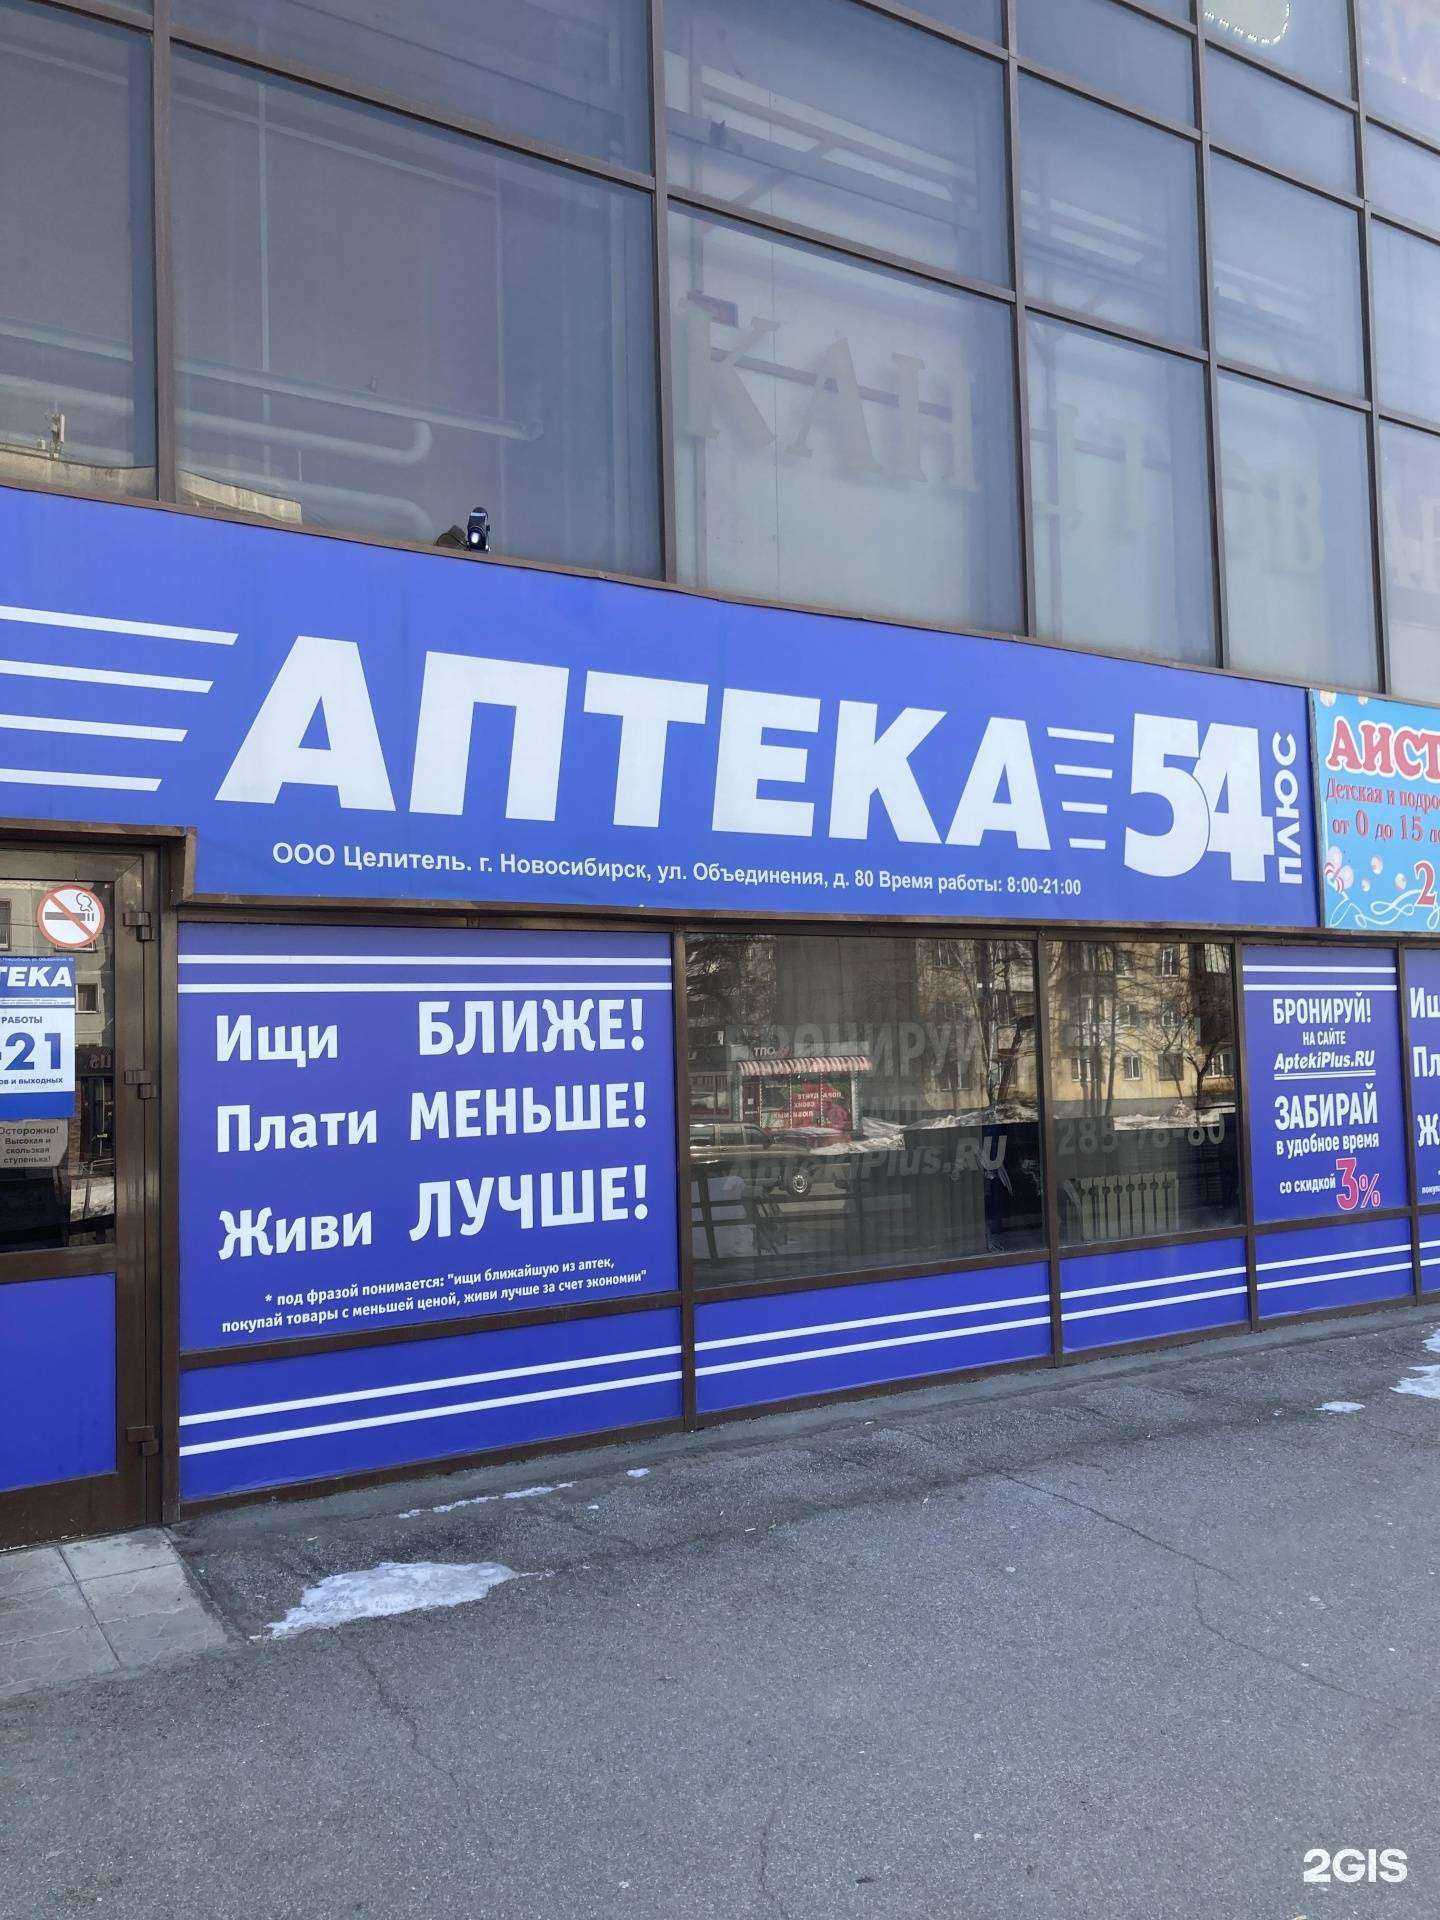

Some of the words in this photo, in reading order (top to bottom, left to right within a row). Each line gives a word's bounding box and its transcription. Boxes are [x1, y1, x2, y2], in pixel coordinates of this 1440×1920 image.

[214, 635, 1051, 850] АПТЕКА
[1123, 713, 1275, 883] 54
[1272, 732, 1303, 884] ПЛЮС
[1326, 777, 1383, 804] Детская
[1387, 790, 1395, 806] и
[1400, 791, 1440, 815] подро
[1332, 819, 1350, 835] от
[1356, 809, 1369, 836] 0
[1374, 824, 1394, 841] до
[1400, 815, 1424, 842] 15
[272, 842, 336, 866] ООО
[344, 845, 472, 872] Целитель.
[479, 856, 493, 873] г.
[500, 853, 652, 882] Новосибирск,
[657, 863, 688, 882] ул.
[693, 862, 829, 888] Объединения,
[833, 872, 850, 888] д.
[854, 869, 875, 888] 80
[879, 870, 934, 893] Время
[938, 876, 1003, 894] работы:
[1006, 876, 1083, 896] 8:00-21:00
[1, 1016, 43, 1024] РАБОТЫ
[1272, 992, 1372, 1024] БРОНИРУЙ!
[0, 1031, 61, 1070] 21
[215, 1013, 339, 1068] Ищи
[417, 998, 646, 1057] БЛИЖЕ!
[1303, 1031, 1316, 1046] НА
[1317, 1027, 1346, 1046] САЙТЕ
[19, 1077, 64, 1086] выходных
[1274, 1050, 1375, 1073] AptekiPlus.RU
[216, 1103, 378, 1153] Плати
[410, 1081, 647, 1142] МЕНЬШЕ!
[1274, 1083, 1378, 1131] ЗАБИРАЙ
[1276, 1140, 1284, 1156] в
[1287, 1133, 1340, 1159] удобное
[1342, 1133, 1380, 1153] время
[1280, 1181, 1292, 1194] со
[1294, 1173, 1336, 1193] скидкой
[1335, 1157, 1381, 1211] 3%
[218, 1205, 374, 1261] Живи
[408, 1164, 649, 1242] ЛУЧШЕ!
[222, 1312, 283, 1333] покупай
[286, 1308, 339, 1325] товары
[342, 1308, 349, 1319] с
[352, 1296, 414, 1318] меньшей
[417, 1292, 461, 1311] ценой,
[463, 1289, 498, 1304] живи
[500, 1285, 540, 1301] лучше
[542, 1282, 556, 1293] за
[558, 1279, 584, 1292] счет
[586, 1269, 648, 1289] экономии"
[277, 1292, 304, 1306] под
[306, 1283, 359, 1306] фразой
[362, 1275, 445, 1298] понимается:
[447, 1273, 482, 1287] "ищи
[484, 1263, 560, 1283] ближайшую
[562, 1261, 576, 1272] из
[578, 1256, 615, 1271] аптек,
